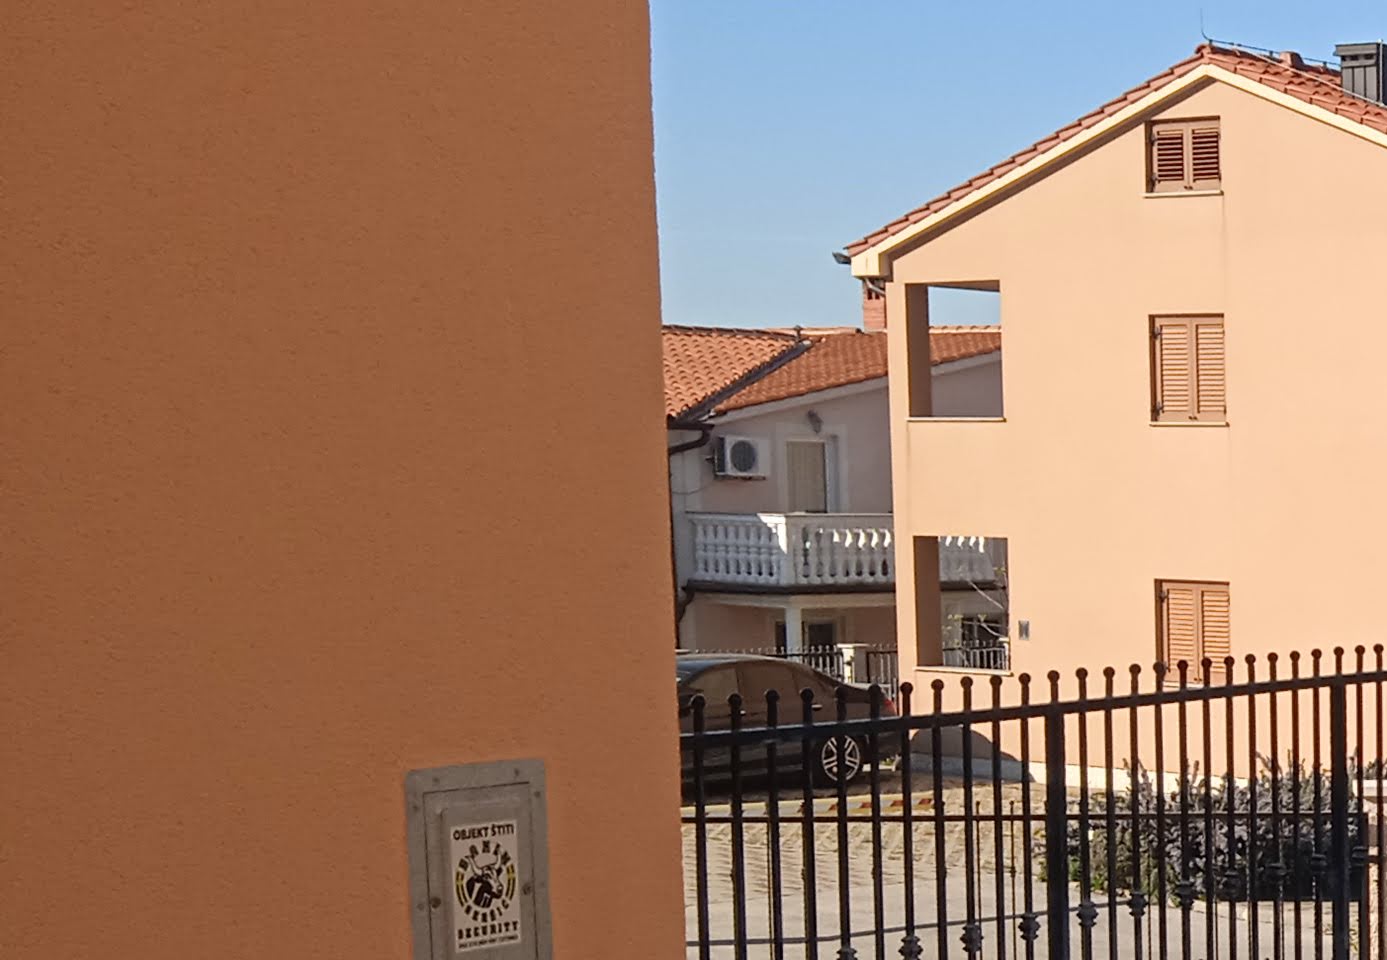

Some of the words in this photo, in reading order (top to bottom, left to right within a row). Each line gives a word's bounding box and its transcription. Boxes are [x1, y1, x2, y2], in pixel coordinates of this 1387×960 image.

[453, 826, 489, 840] OBJEKT
[491, 823, 514, 836] ŠTITI
[458, 921, 518, 939] SECURITY
